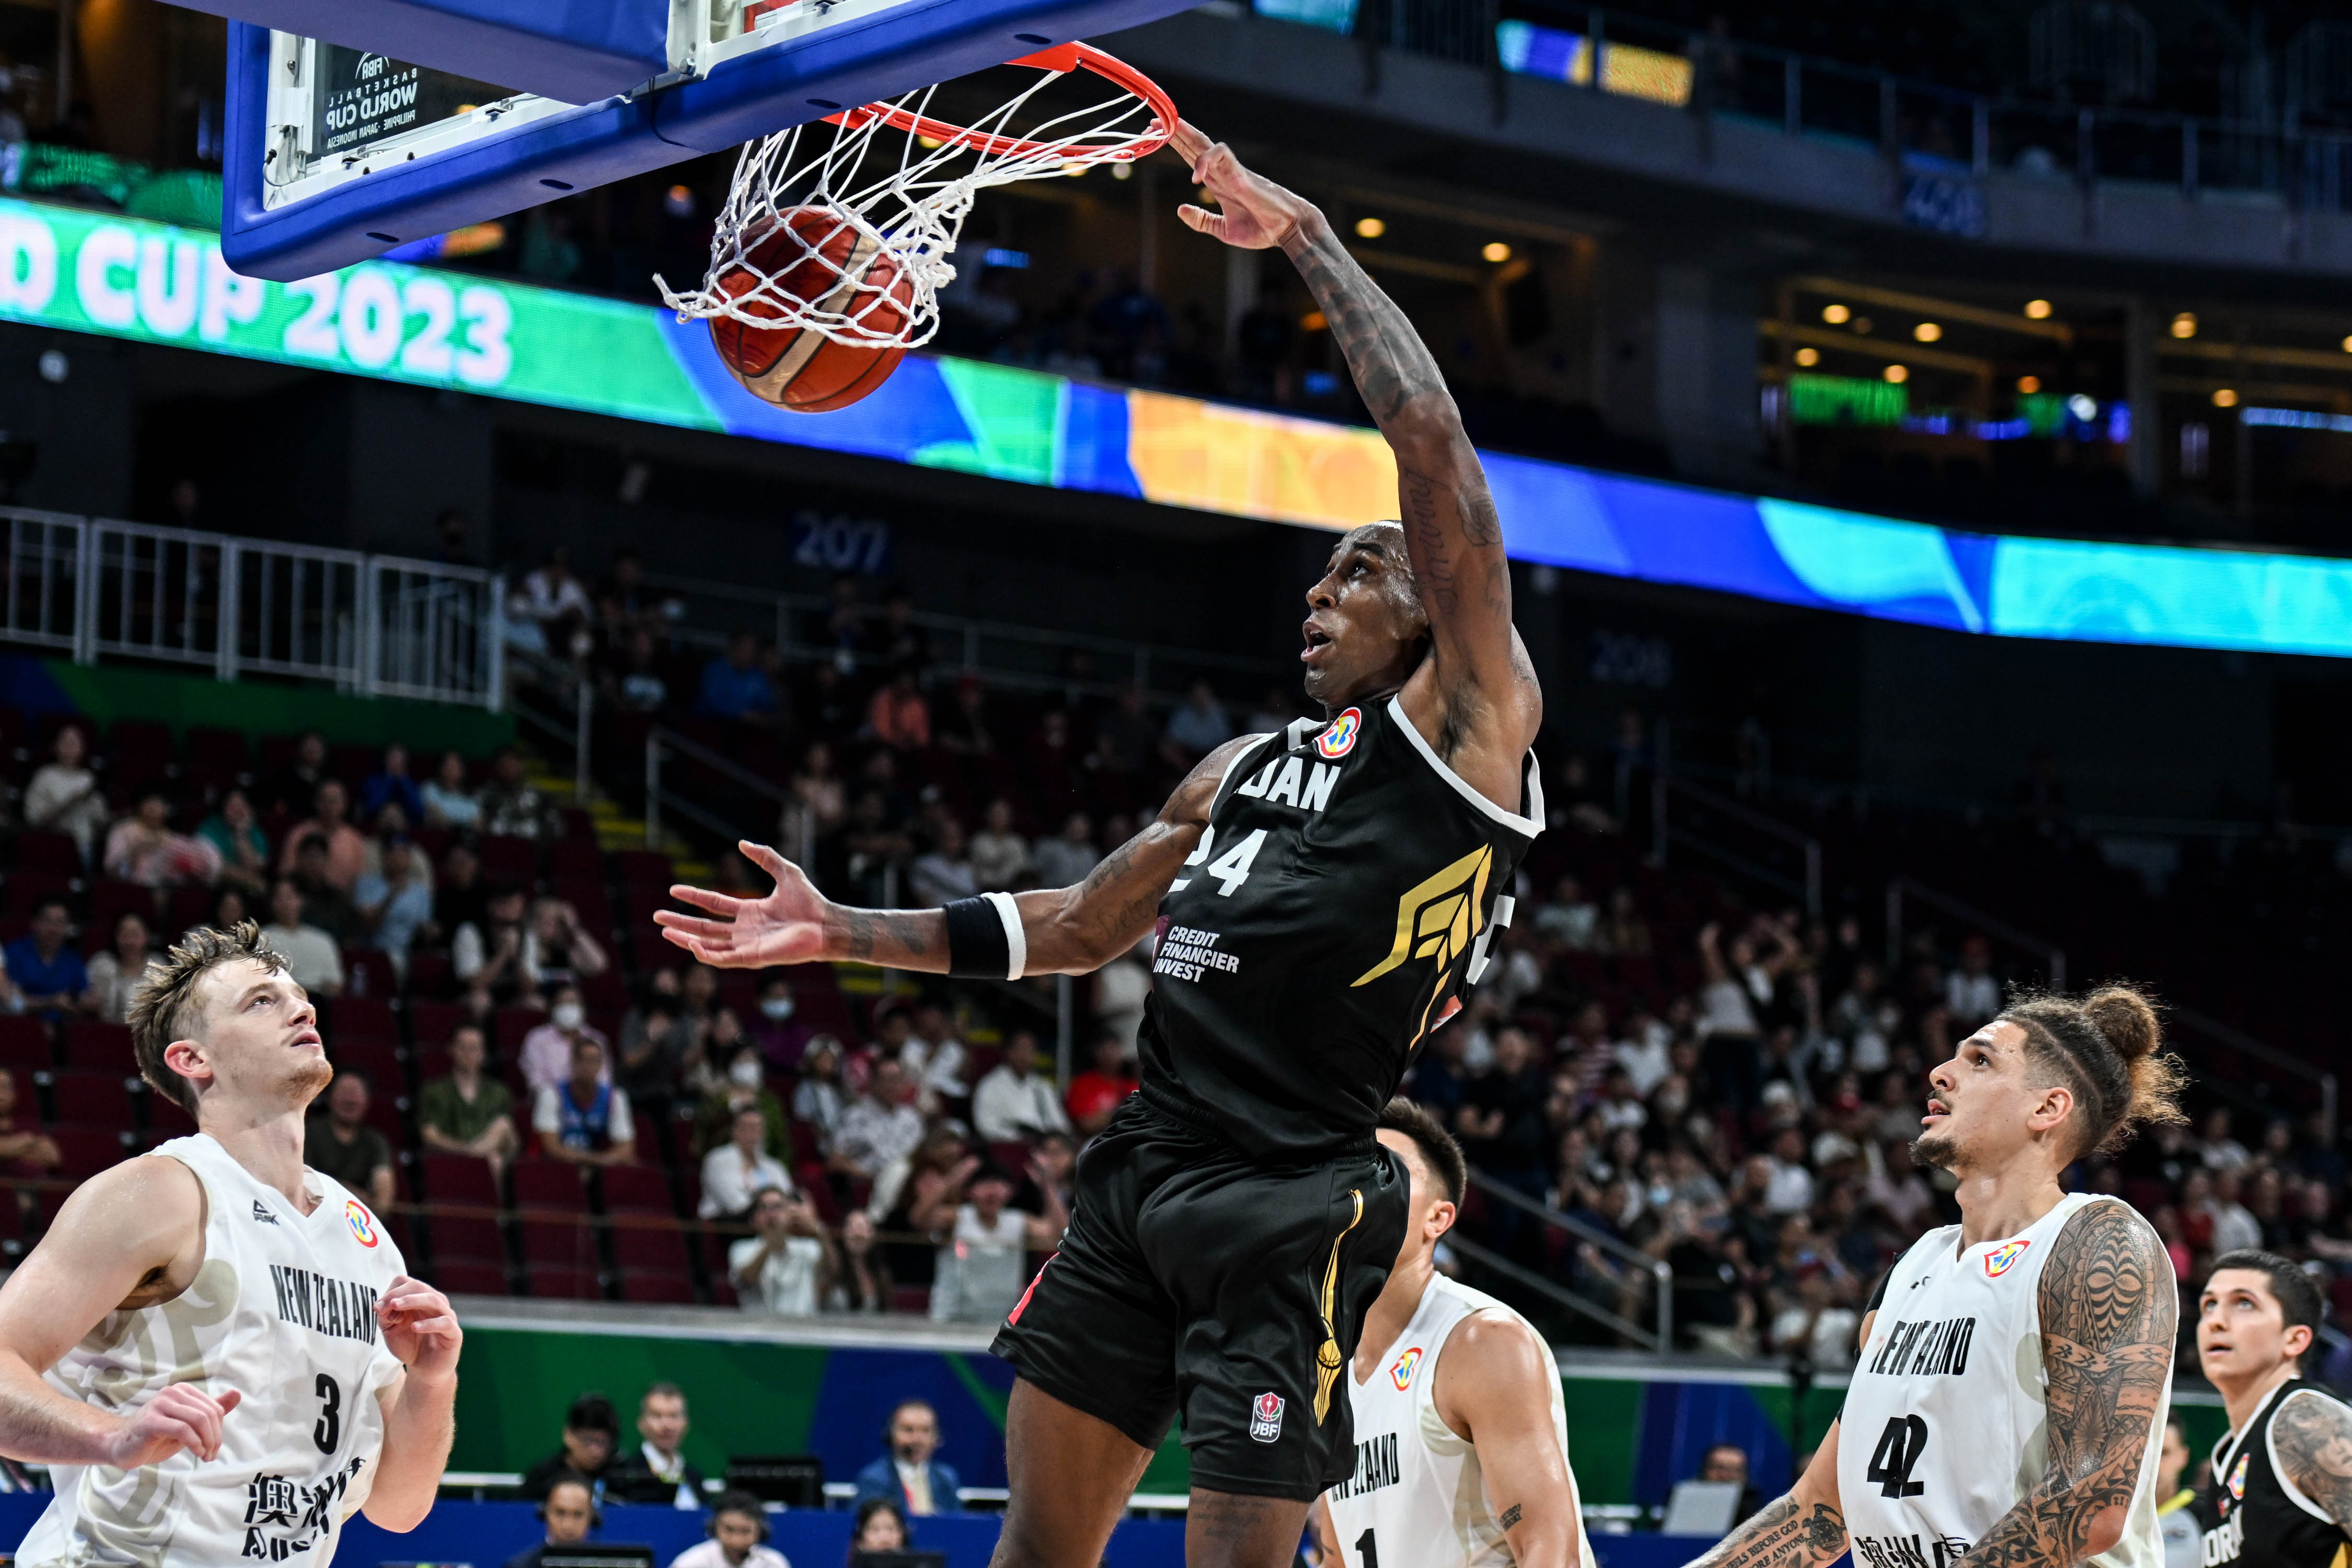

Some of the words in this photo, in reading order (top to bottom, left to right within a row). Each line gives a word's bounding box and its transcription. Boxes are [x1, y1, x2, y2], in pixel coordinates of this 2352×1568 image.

[78, 225, 259, 342] CUP
[286, 271, 509, 384] 2023
[792, 509, 886, 573] 207
[1168, 926, 1220, 948] CREDIT
[1153, 958, 1205, 983] INVEST
[1159, 942, 1240, 973] FINANCIER
[269, 1264, 312, 1328] NEW
[313, 1273, 377, 1346] ZEALAND
[314, 1373, 340, 1455] 3
[1253, 1422, 1278, 1437] JBF
[1866, 1414, 1928, 1499] 42
[1355, 1528, 1379, 1568] 1
[1747, 1531, 1782, 1557] BEFORE
[1780, 1520, 1798, 1536] GOD
[1772, 1533, 1806, 1562] ANYONE
